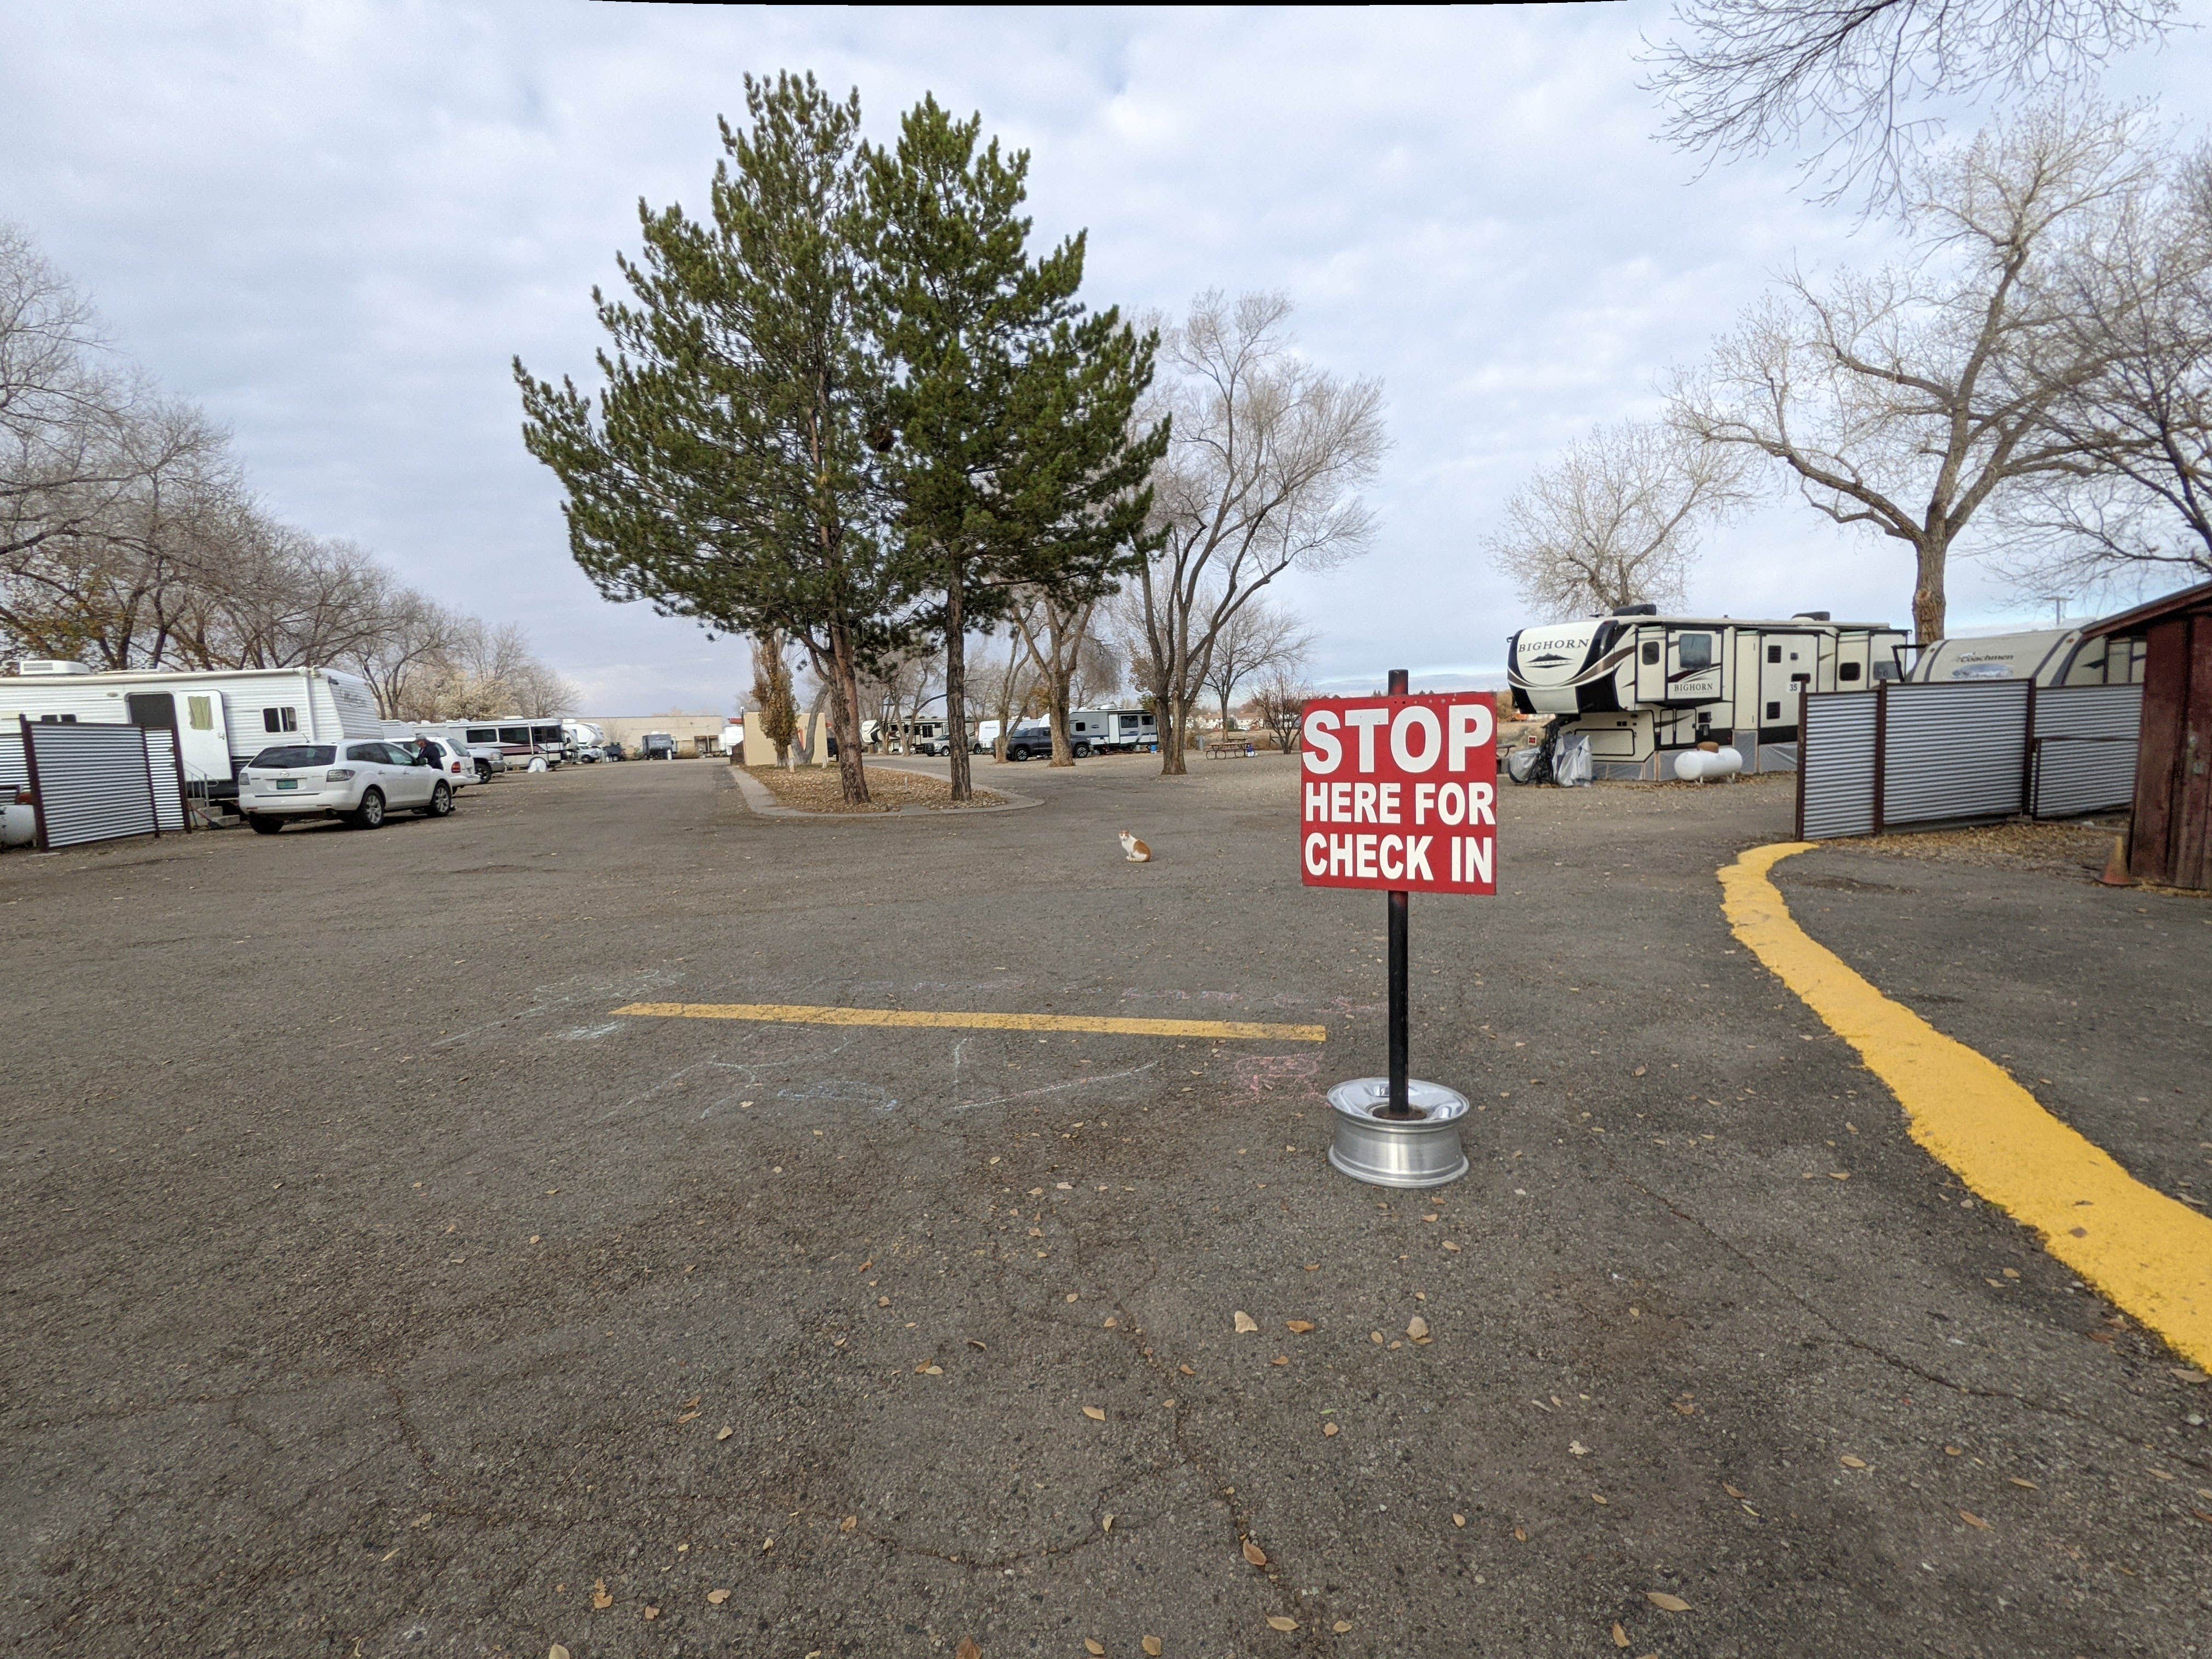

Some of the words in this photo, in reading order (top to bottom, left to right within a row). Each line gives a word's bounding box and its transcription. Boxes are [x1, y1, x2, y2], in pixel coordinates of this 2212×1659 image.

[1519, 639, 1590, 652] BIGHORN
[1674, 683, 1713, 691] BIGHORN
[1302, 704, 1493, 774] STOP
[1306, 782, 1401, 823] HERE
[1415, 782, 1496, 825] FOR
[1305, 832, 1434, 881] CHECK
[1451, 836, 1492, 883] IN
